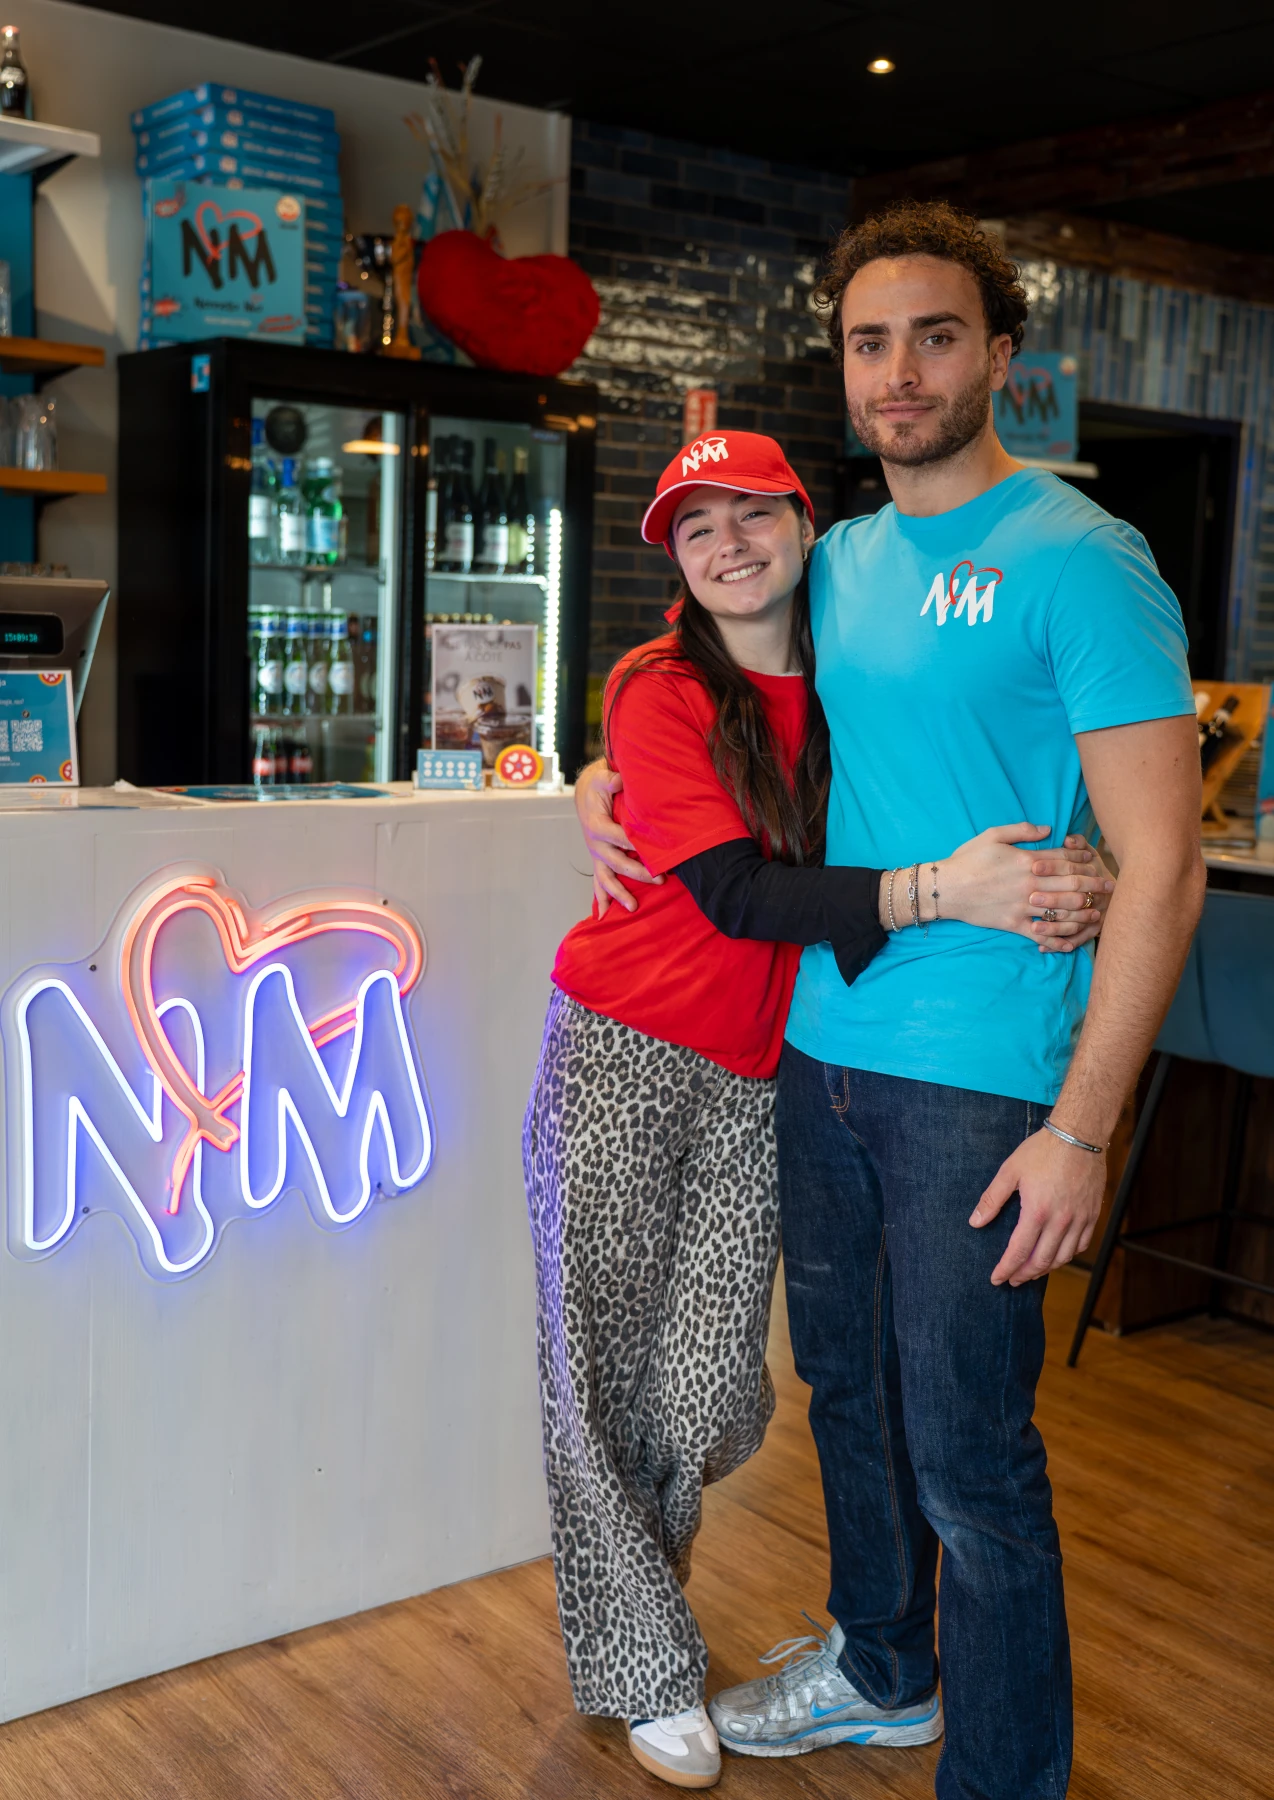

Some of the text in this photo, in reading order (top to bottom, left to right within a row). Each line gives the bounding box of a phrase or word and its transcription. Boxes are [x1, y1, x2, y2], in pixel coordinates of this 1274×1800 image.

[181, 217, 278, 291] NM
[682, 440, 729, 477] NM
[919, 572, 997, 627] NM
[17, 962, 431, 1274] NM
